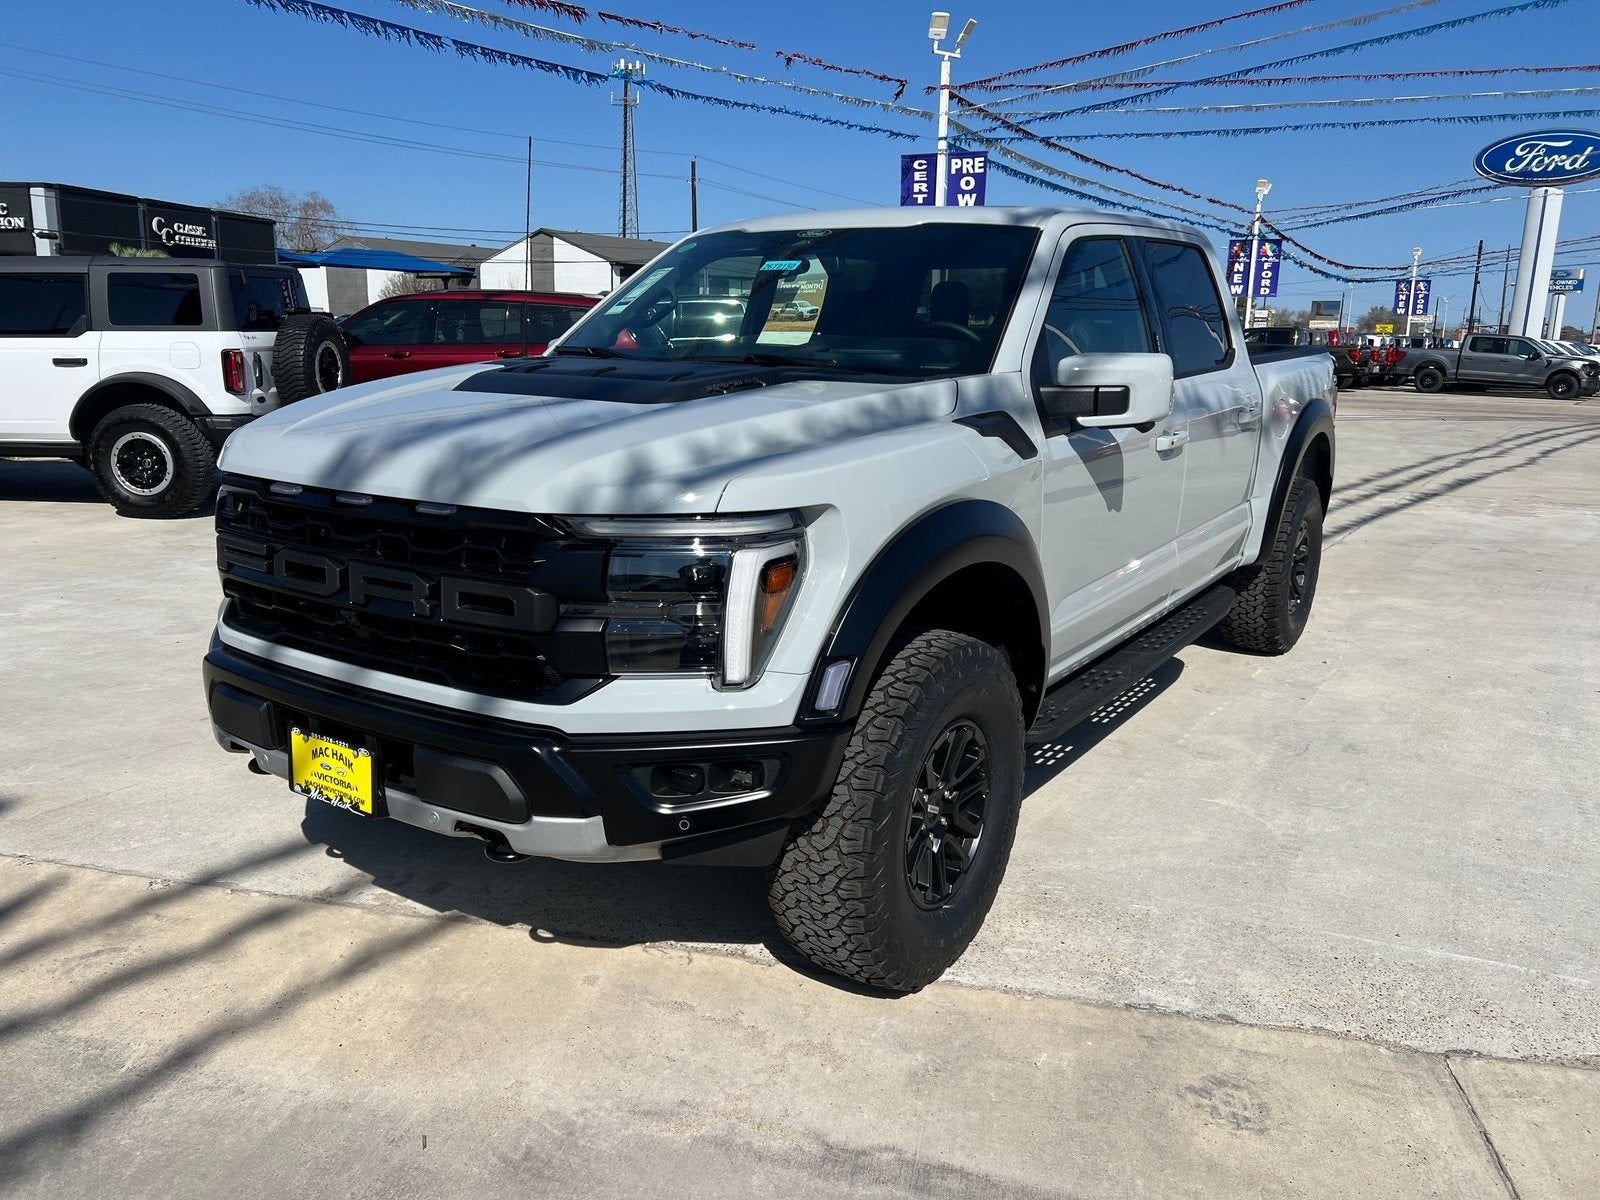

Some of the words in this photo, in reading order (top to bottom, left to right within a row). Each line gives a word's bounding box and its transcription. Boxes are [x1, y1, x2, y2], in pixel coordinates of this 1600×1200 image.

[951, 157, 985, 174] PRE
[1504, 140, 1594, 172] Ford
[174, 223, 206, 236] CLASSIC
[1230, 262, 1244, 294] NEW
[1260, 262, 1272, 294] FORD
[1396, 294, 1406, 315] NEW
[216, 533, 558, 632] FORD
[311, 747, 330, 761] MAC
[331, 748, 354, 773] HAIK
[316, 772, 352, 791] VICTORIA
[309, 788, 330, 803] Mac
